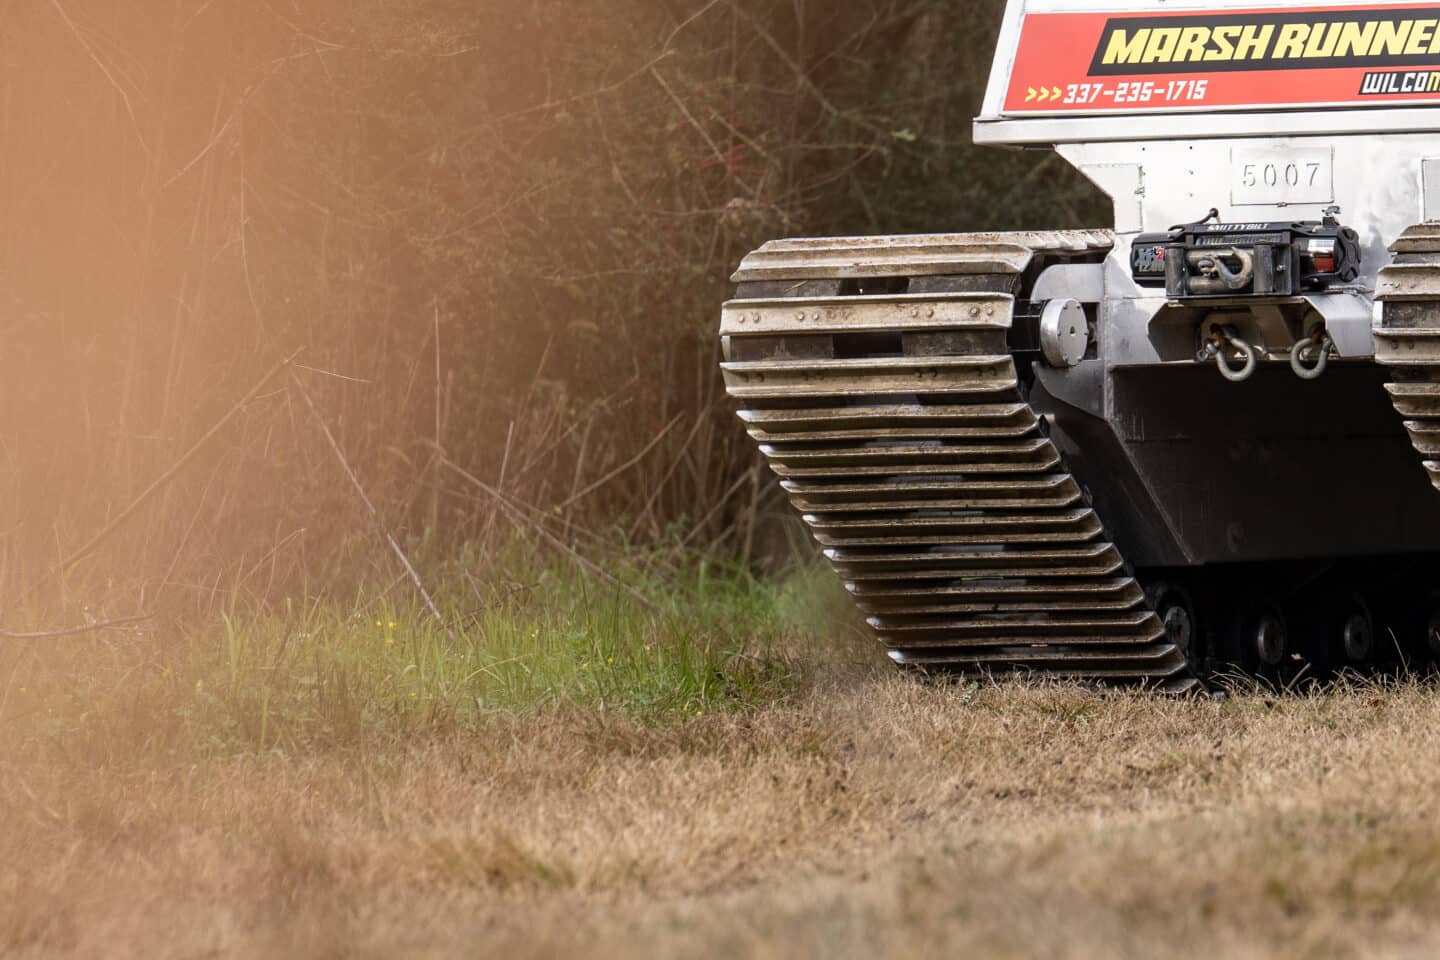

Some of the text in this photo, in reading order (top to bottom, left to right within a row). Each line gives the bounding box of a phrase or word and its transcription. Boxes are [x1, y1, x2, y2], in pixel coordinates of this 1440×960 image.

[1101, 25, 1275, 65] MARSH
[1063, 80, 1208, 103] 337-235-1715
[1243, 163, 1320, 187] 5007
